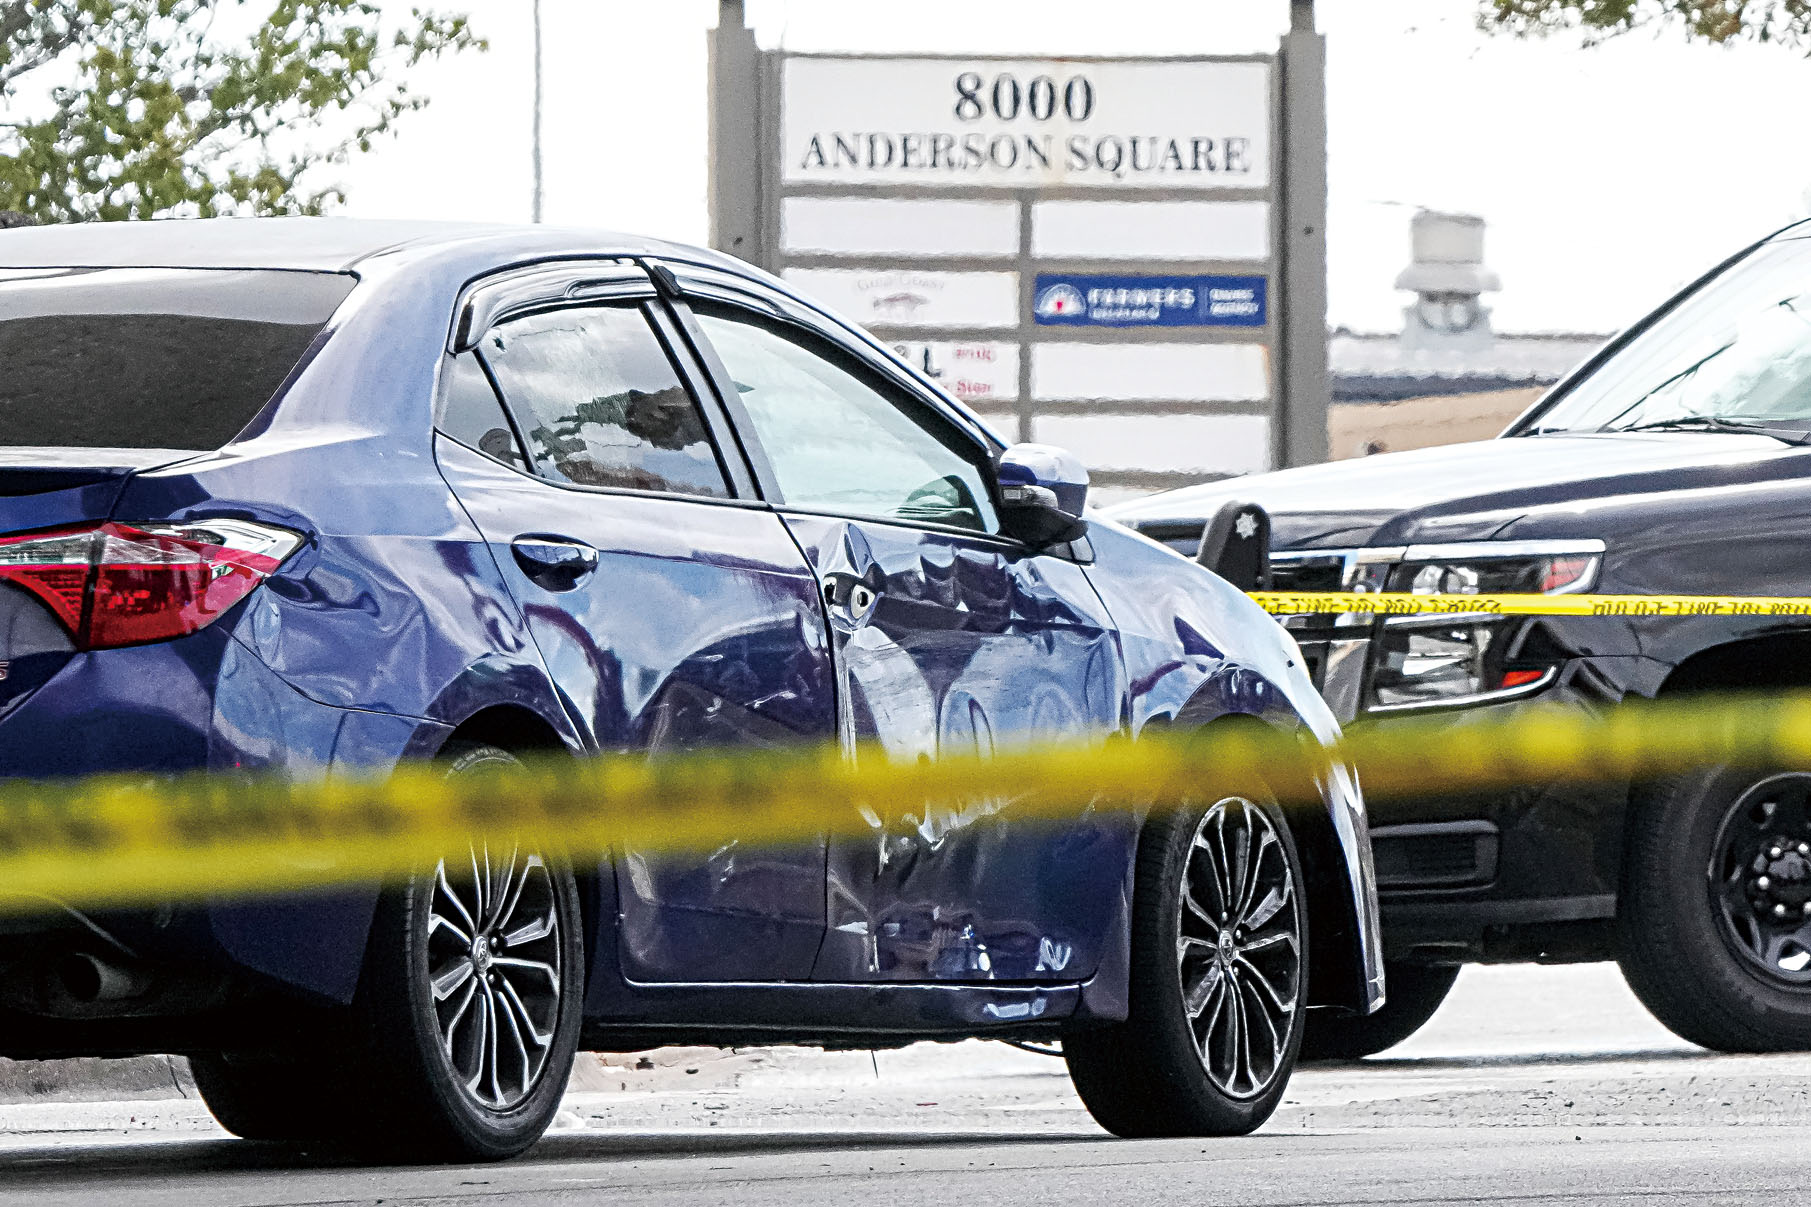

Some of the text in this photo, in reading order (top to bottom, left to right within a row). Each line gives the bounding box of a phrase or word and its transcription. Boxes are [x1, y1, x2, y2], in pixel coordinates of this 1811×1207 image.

[953, 72, 1096, 122] 8000
[801, 132, 1251, 178] ANDERSON SQUARE
